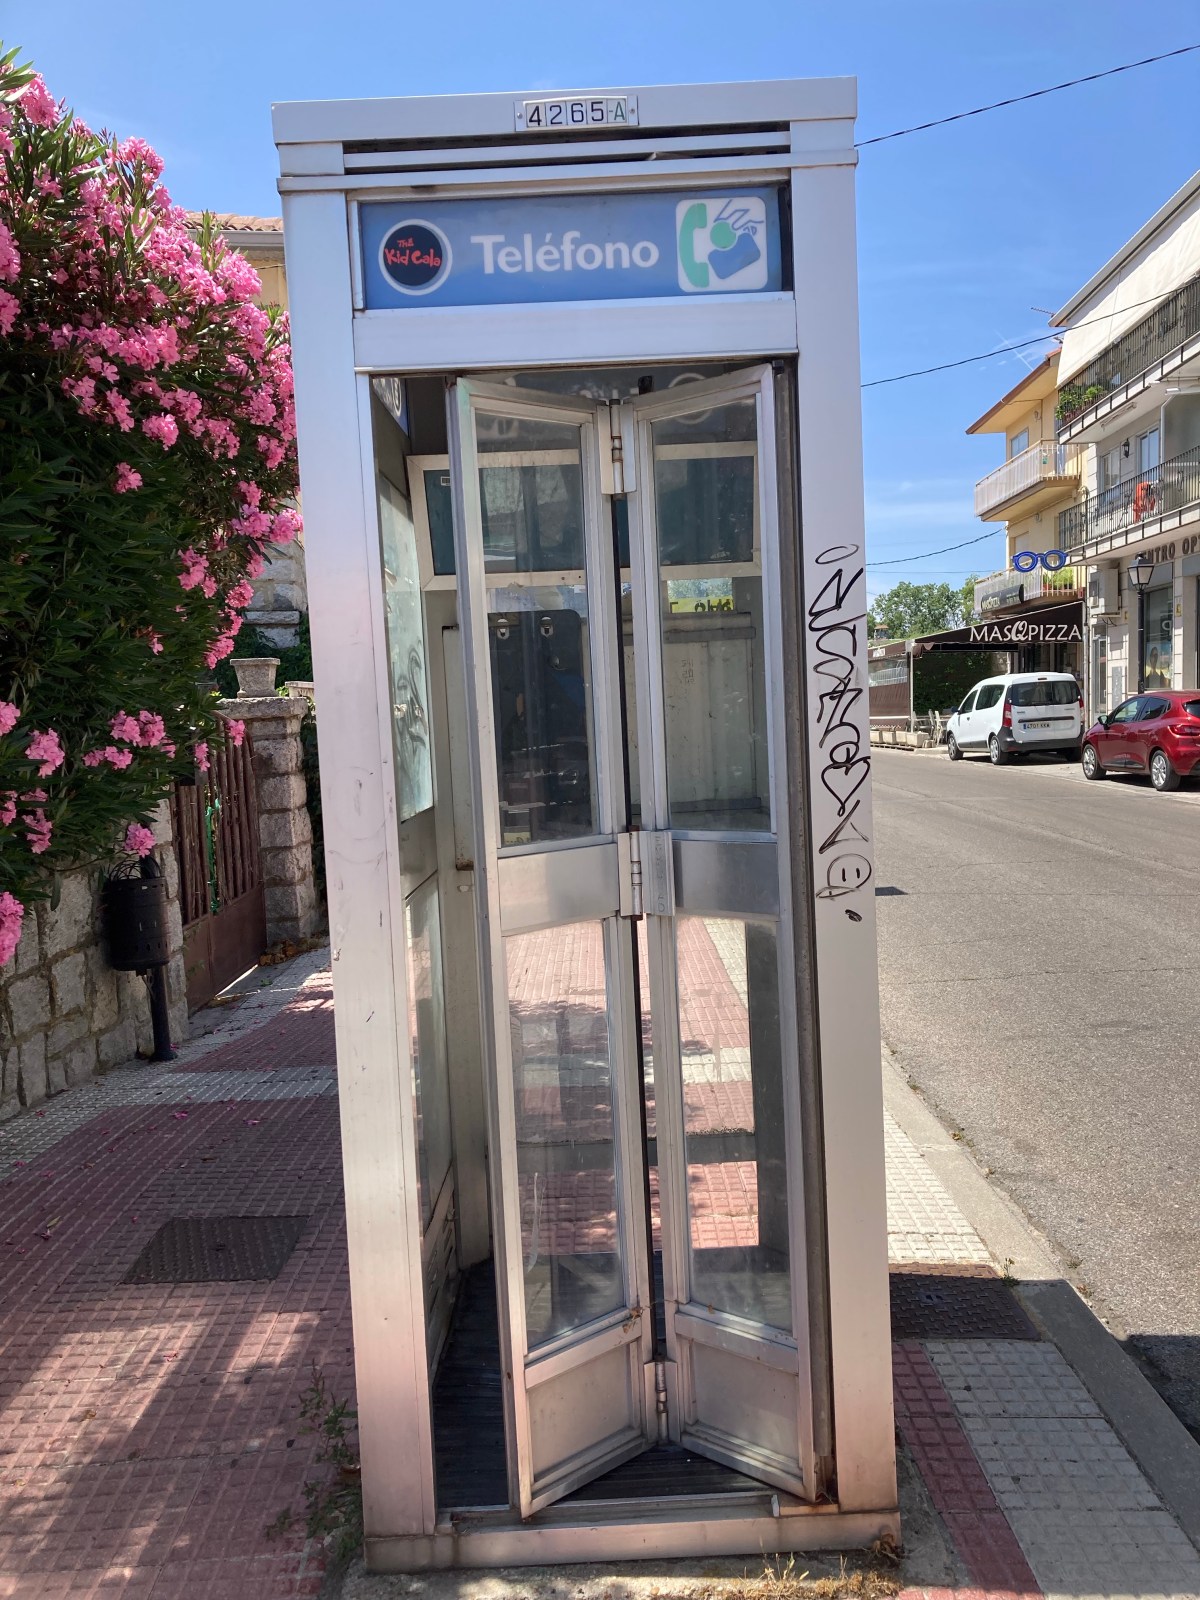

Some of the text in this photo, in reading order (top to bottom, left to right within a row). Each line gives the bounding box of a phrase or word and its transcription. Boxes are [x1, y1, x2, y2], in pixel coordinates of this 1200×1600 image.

[385, 248, 442, 268] Kid Cala
[470, 231, 660, 274] Teléfono
[1182, 535, 1200, 555] OP
[969, 620, 1082, 642] MASQPIZZA
